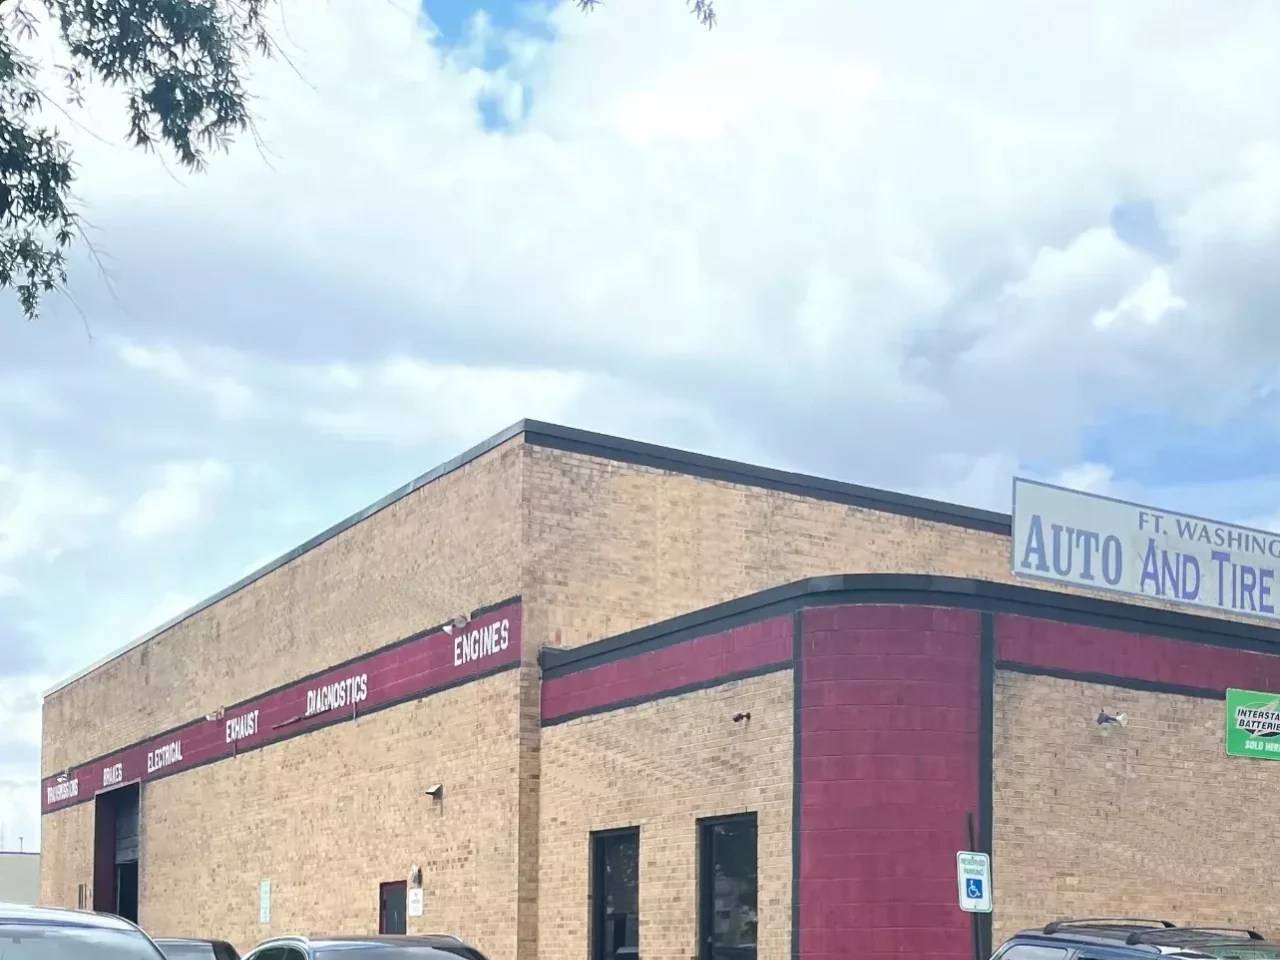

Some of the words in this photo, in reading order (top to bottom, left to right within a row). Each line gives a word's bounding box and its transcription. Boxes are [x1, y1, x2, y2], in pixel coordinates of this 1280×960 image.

[1138, 511, 1168, 535] FT.
[1021, 514, 1123, 586] AUTO
[1140, 537, 1200, 601] AND
[1211, 551, 1275, 614] TIRE
[454, 618, 510, 667] ENGINES
[305, 673, 368, 716] DIAGNOSTICS
[226, 709, 259, 743] EXHAUST
[147, 740, 183, 773] ELECTRICAL
[1244, 740, 1264, 751] SOLD
